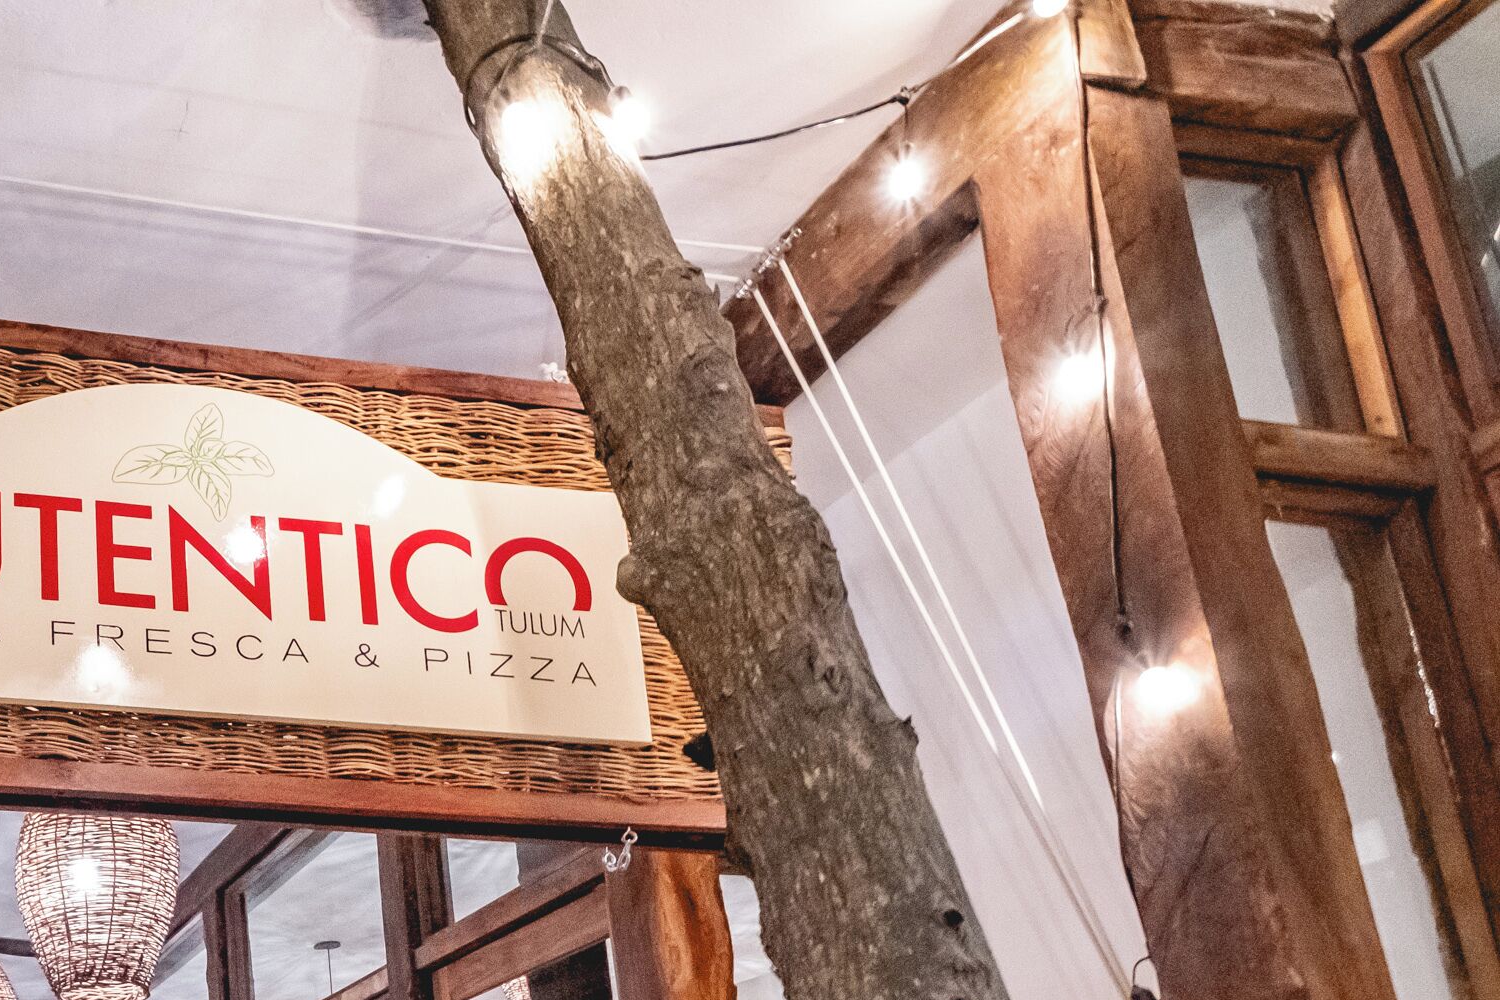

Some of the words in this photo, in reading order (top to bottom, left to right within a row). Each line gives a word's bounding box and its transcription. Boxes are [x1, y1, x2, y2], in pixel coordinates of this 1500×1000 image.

[494, 608, 585, 639] TULUM
[50, 619, 310, 664] FRESCA
[353, 643, 380, 669] &
[423, 647, 597, 687] PIZZA
